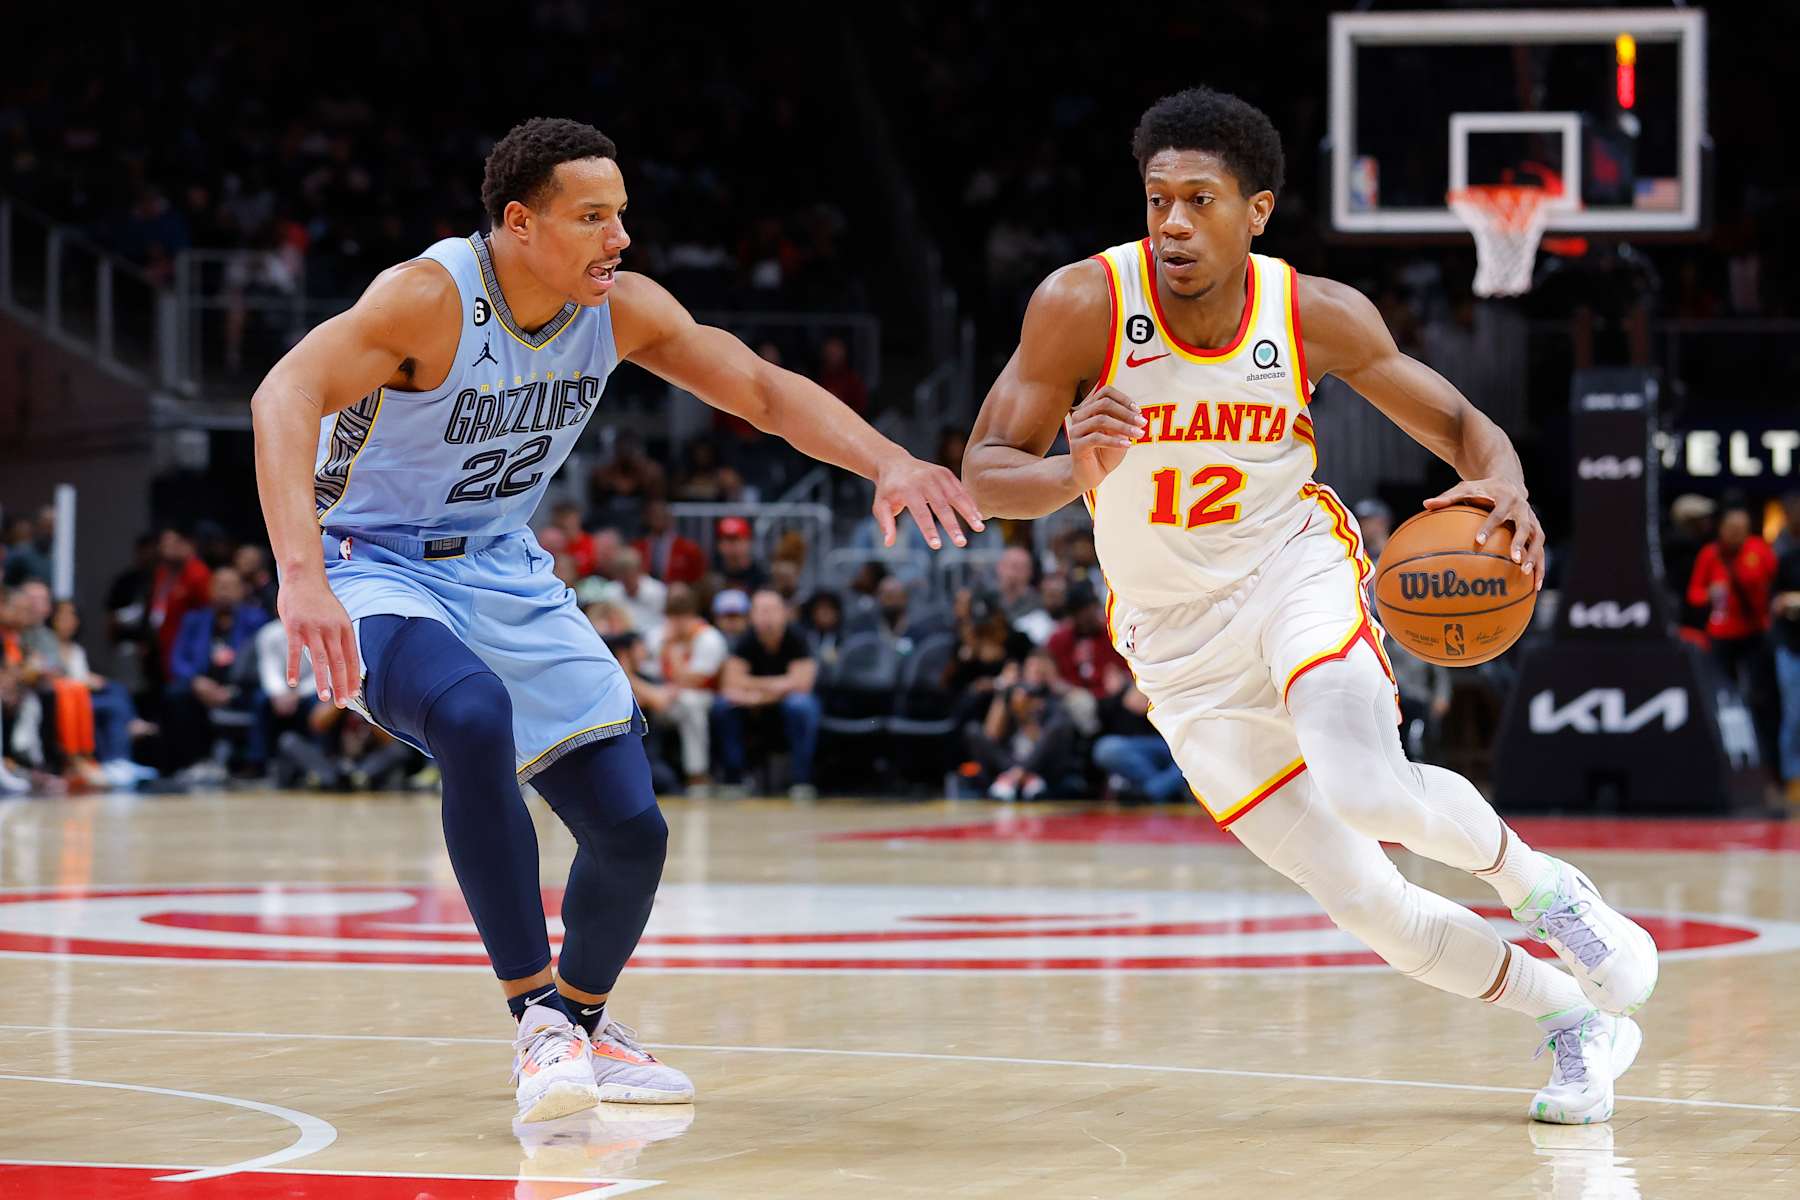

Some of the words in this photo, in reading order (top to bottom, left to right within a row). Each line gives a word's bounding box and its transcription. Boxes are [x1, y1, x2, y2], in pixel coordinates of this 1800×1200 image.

[474, 301, 486, 323] 6
[1131, 318, 1148, 341] 6
[1246, 371, 1286, 382] sharecare
[444, 375, 600, 445] GRIZZLIES
[1129, 400, 1288, 445] TLANTA
[445, 435, 553, 505] 22
[1148, 463, 1249, 532] 12
[1399, 569, 1508, 600] Wilson
[1528, 687, 1690, 734] KIA
